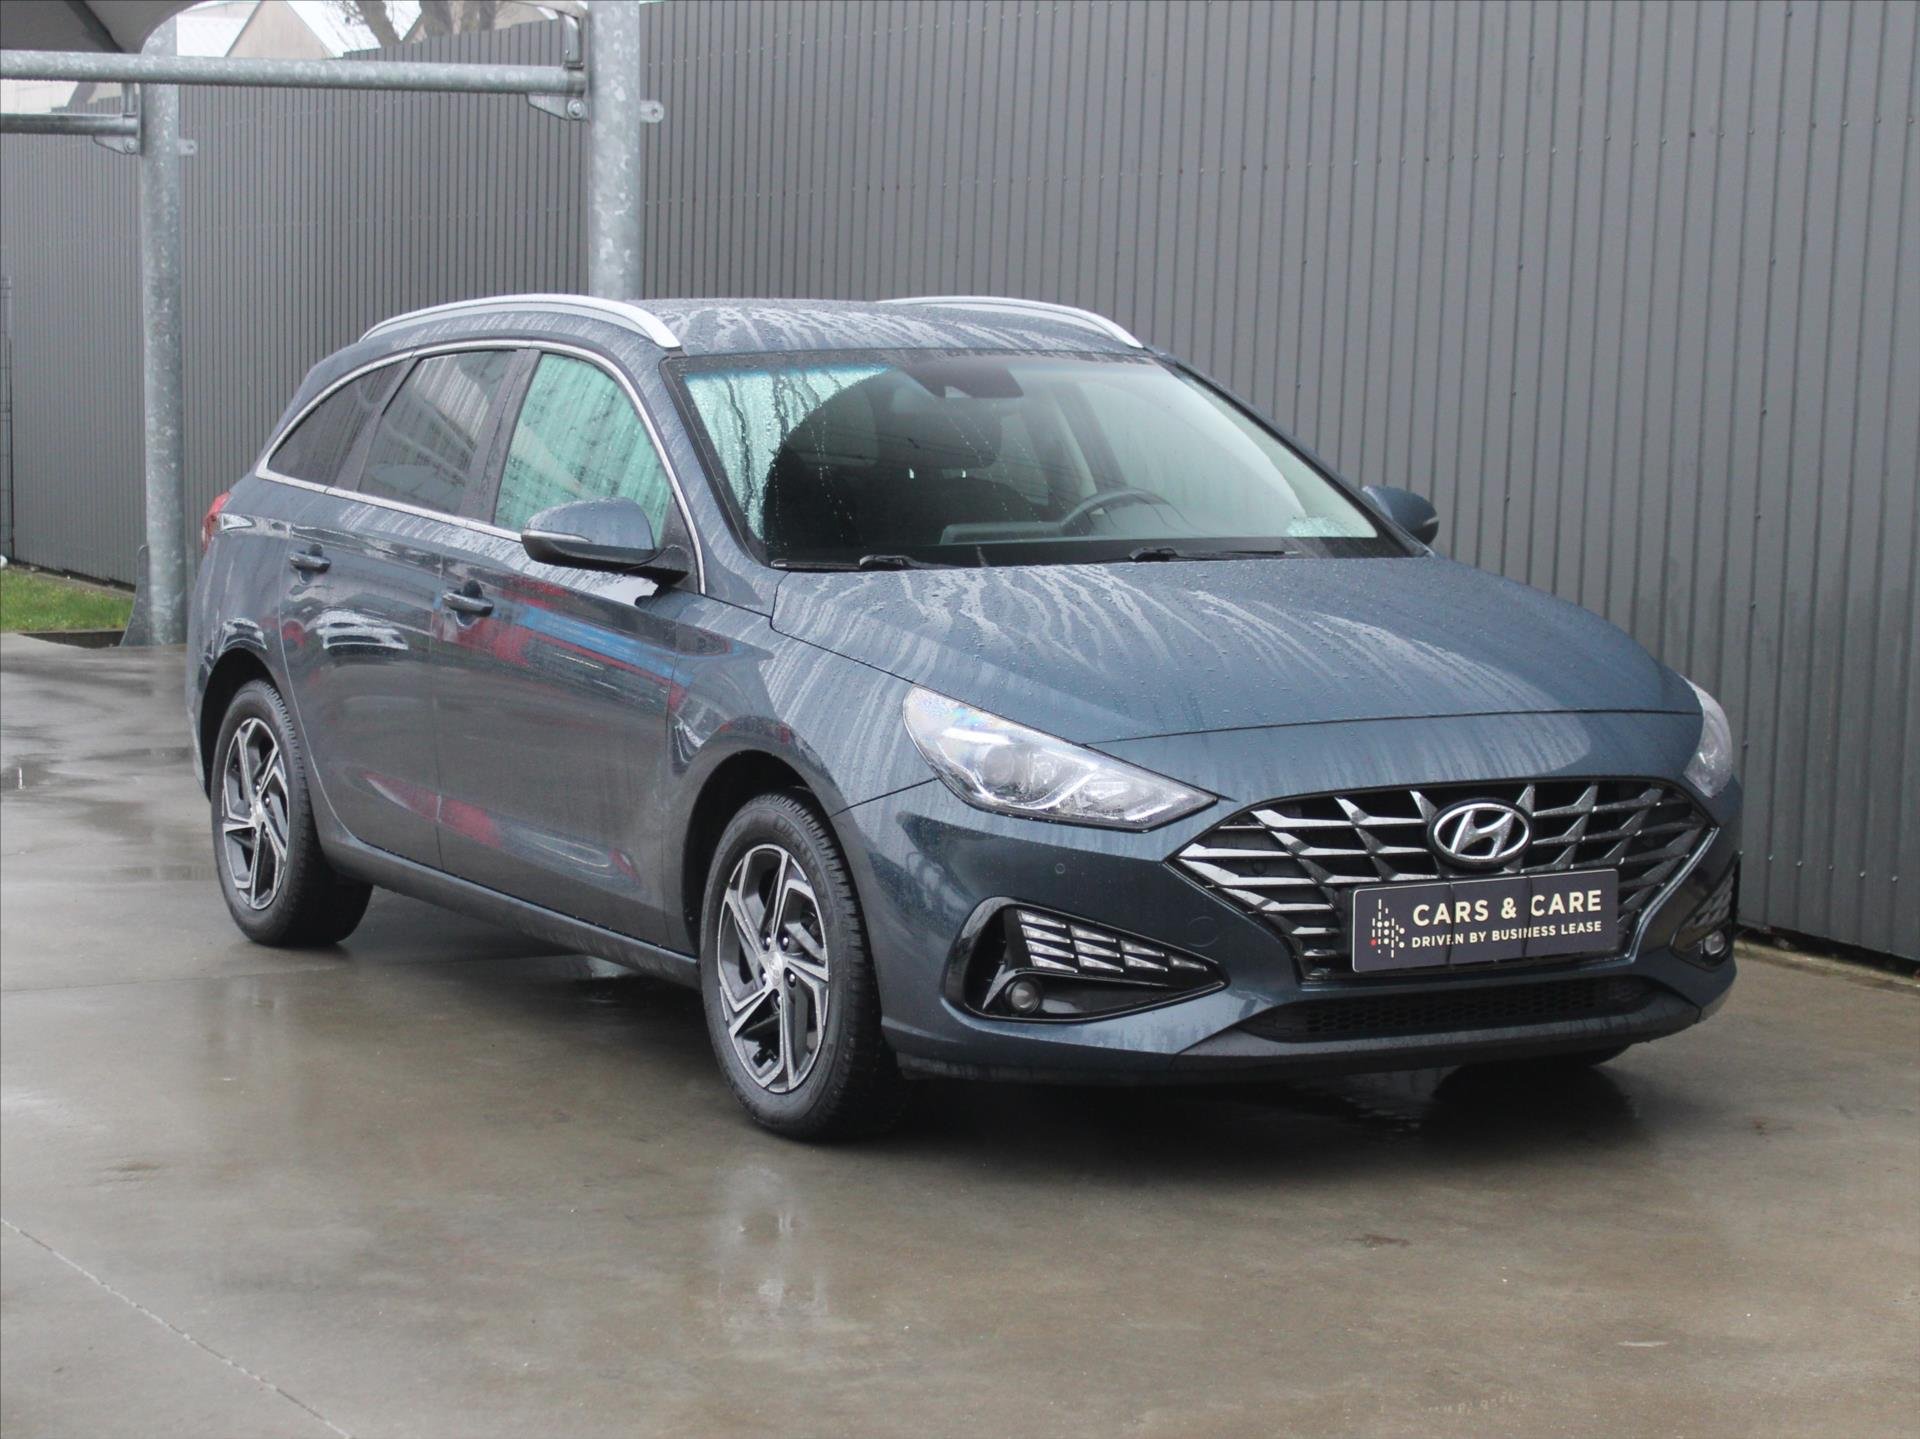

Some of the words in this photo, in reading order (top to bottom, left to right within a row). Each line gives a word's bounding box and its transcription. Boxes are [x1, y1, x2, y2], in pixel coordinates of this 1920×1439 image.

[1412, 900, 1489, 927] CARS
[1500, 897, 1517, 919] &
[1530, 890, 1602, 917] CARE
[1411, 933, 1464, 948] DRIVEN
[1469, 931, 1487, 944] BY
[1492, 925, 1556, 941] BUSINESS
[1561, 921, 1602, 936] LEASE
